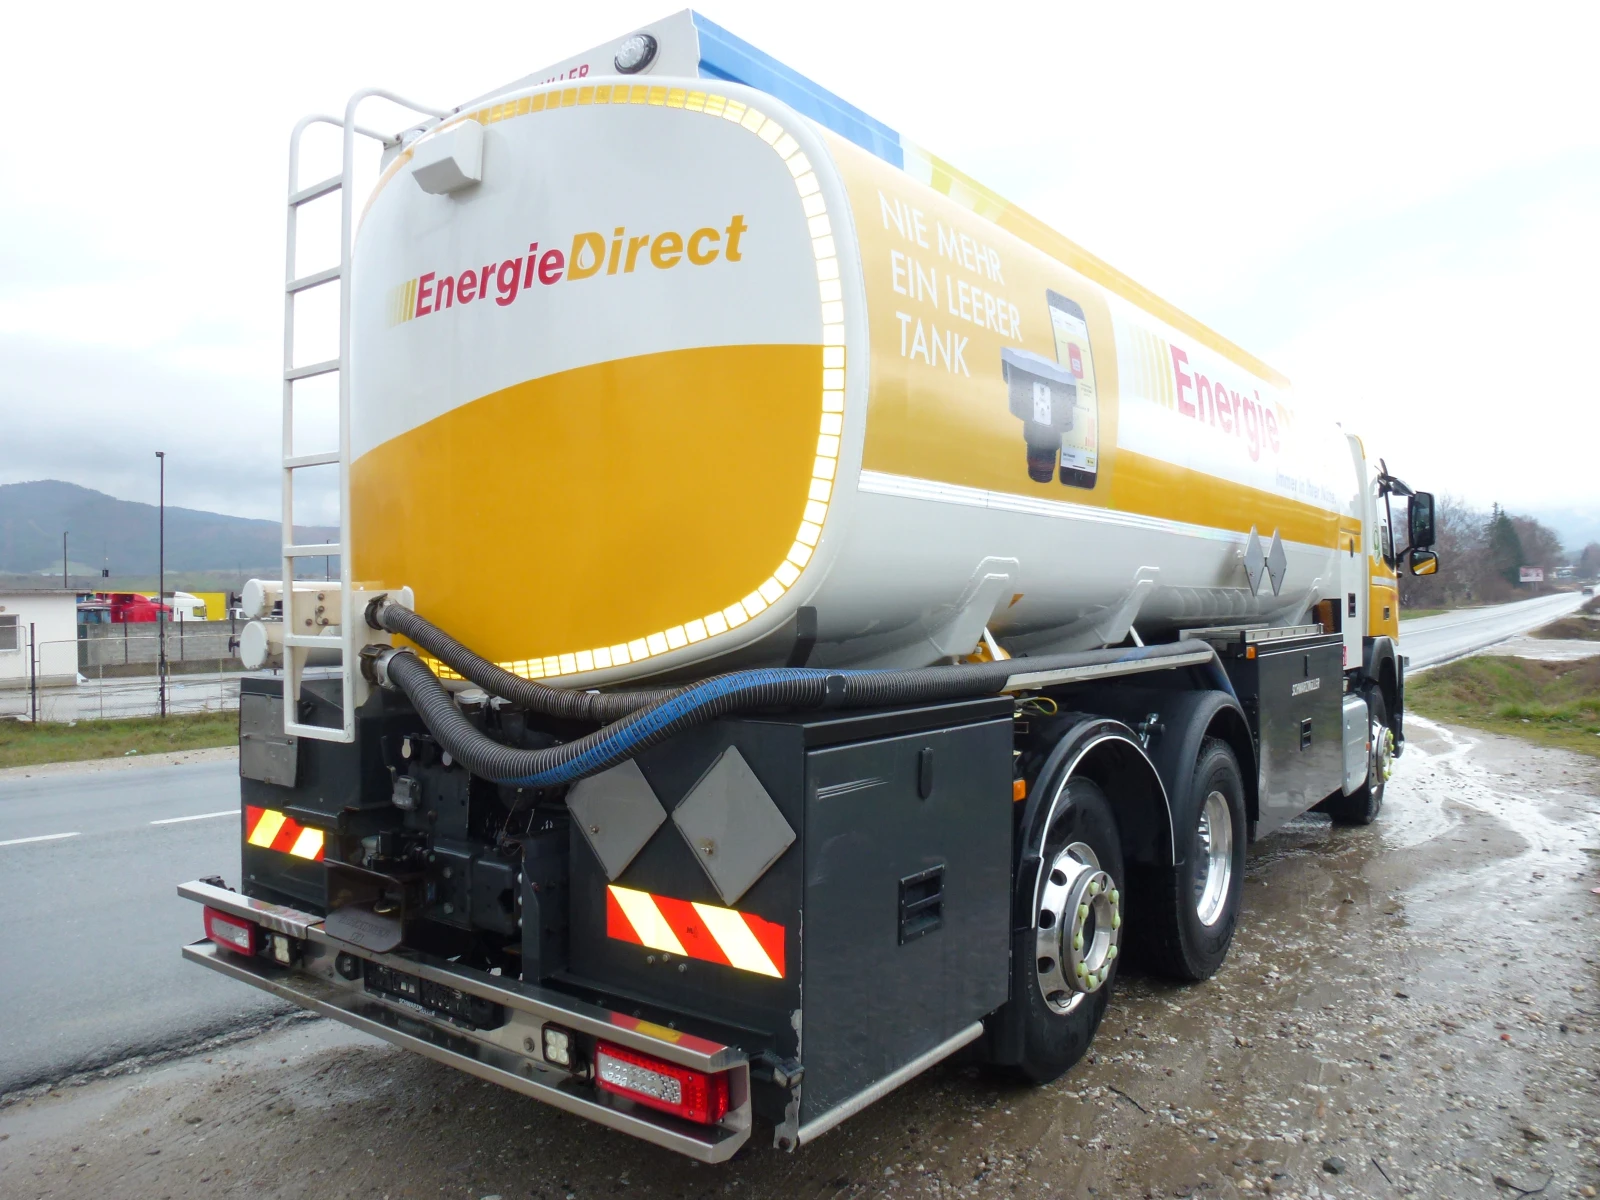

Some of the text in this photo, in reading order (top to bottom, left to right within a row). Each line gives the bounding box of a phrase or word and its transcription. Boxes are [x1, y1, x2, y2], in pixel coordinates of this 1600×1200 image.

[415, 214, 748, 318] EnergieDirect
[878, 189, 1005, 285] NIE MEHR
[891, 249, 1023, 342] EIN LEERER
[896, 311, 970, 378] TANK
